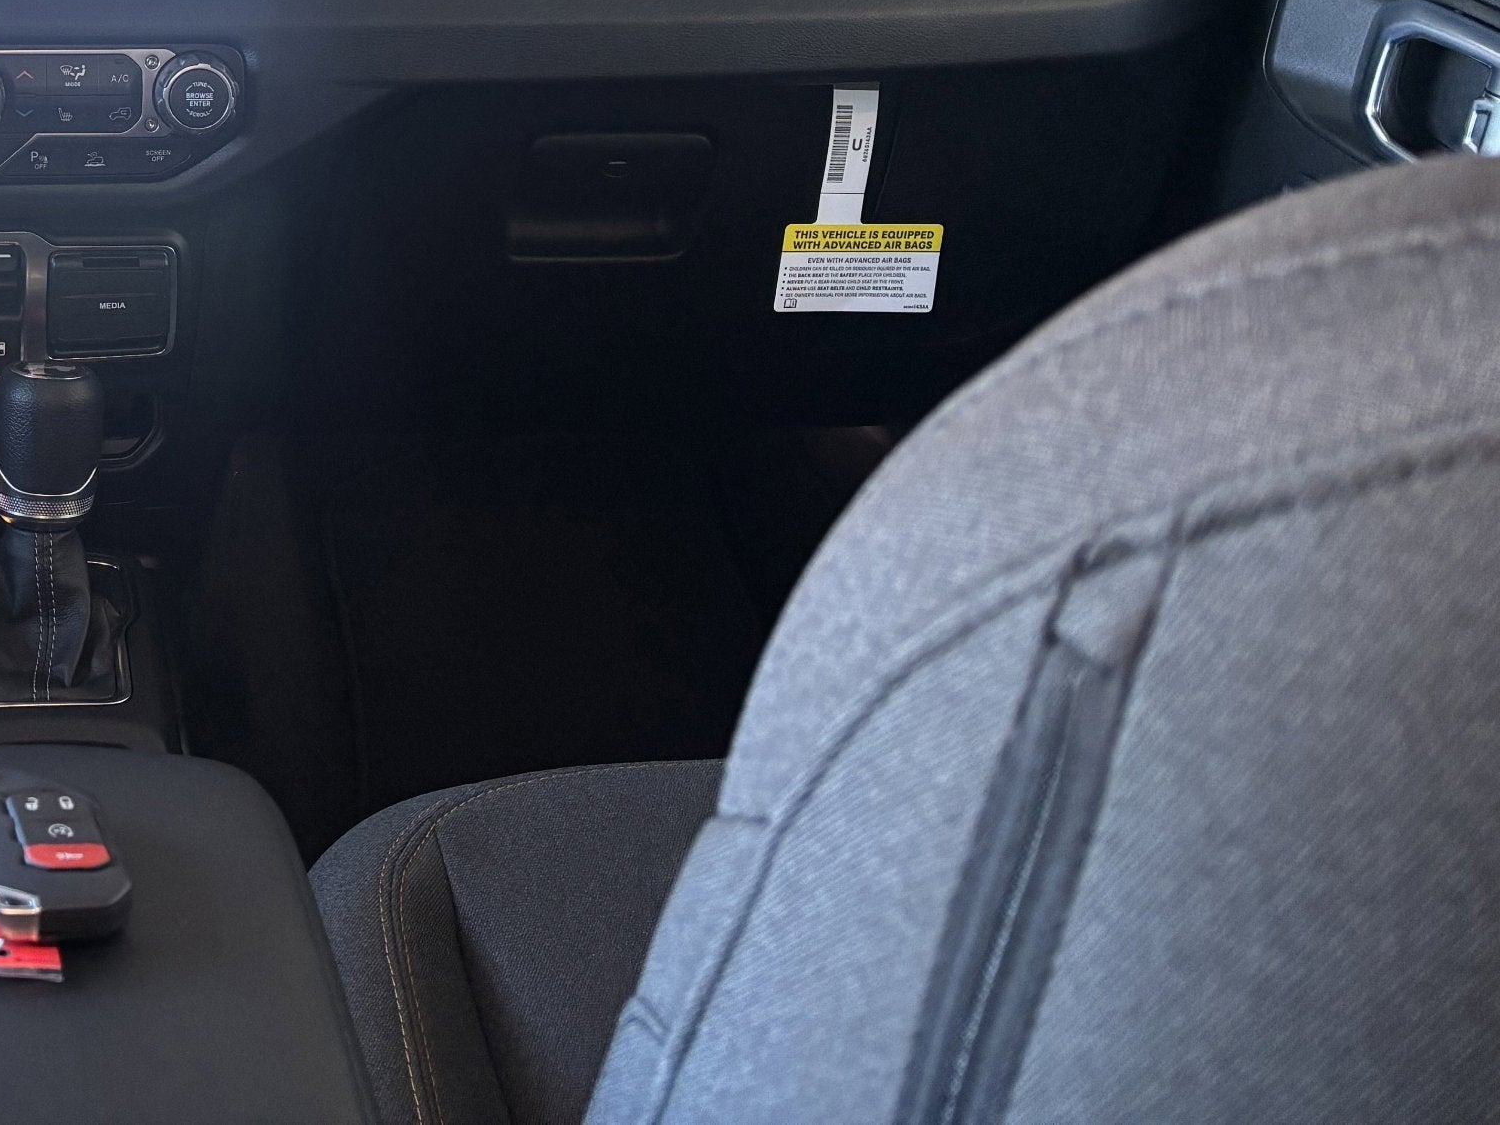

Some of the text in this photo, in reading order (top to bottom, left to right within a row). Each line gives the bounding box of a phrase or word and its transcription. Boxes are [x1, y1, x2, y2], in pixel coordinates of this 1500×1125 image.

[110, 75, 129, 83] A/C
[852, 138, 863, 151] U
[795, 230, 935, 239] THIS VEHICLE IS EQUIPPED
[793, 241, 933, 250] WITH ADVANCED AIR BAGS
[99, 302, 126, 310] MEDIA
